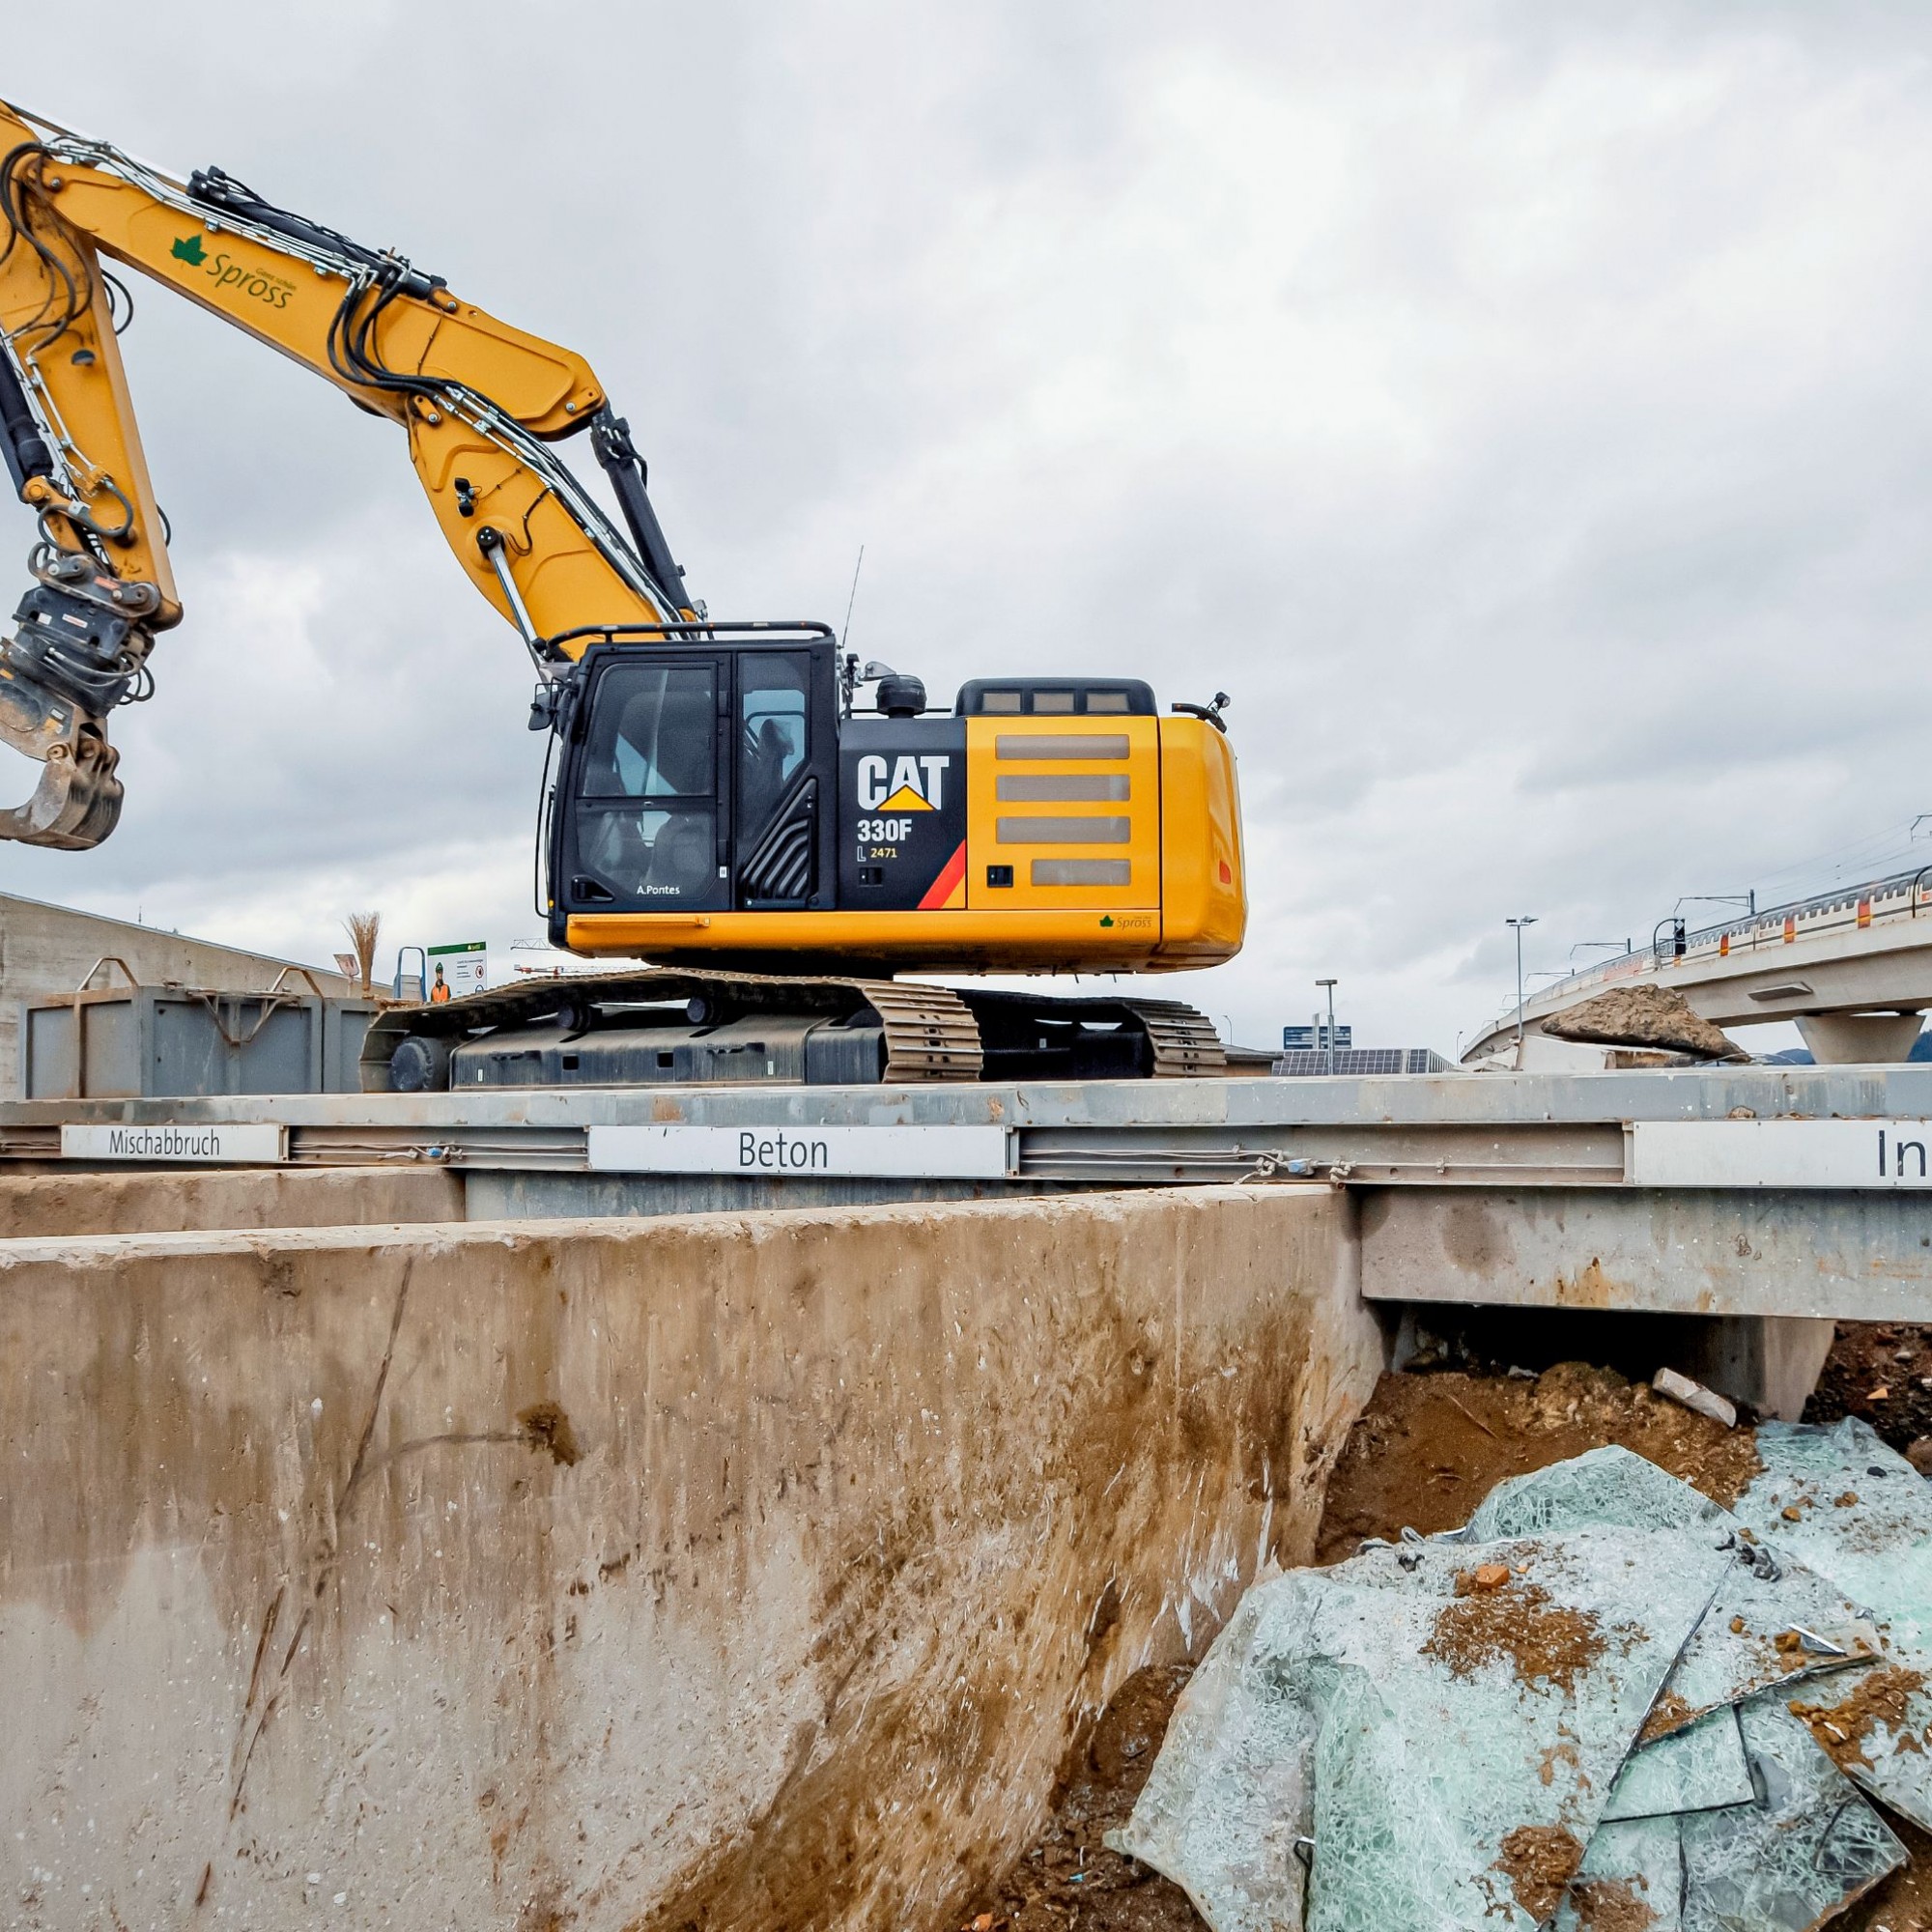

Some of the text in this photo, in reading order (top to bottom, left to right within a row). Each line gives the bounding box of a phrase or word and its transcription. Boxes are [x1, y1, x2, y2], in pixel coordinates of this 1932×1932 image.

[206, 254, 293, 309] Spross
[857, 754, 950, 811] CAT
[857, 818, 913, 841] 330F
[857, 845, 867, 863] L
[870, 847, 897, 859] 2471
[637, 885, 681, 895] A.Pontes
[1117, 917, 1152, 930] Spross
[109, 1128, 220, 1155] Mischabbruch
[739, 1132, 828, 1168] Beton
[1878, 1129, 1926, 1178] In
